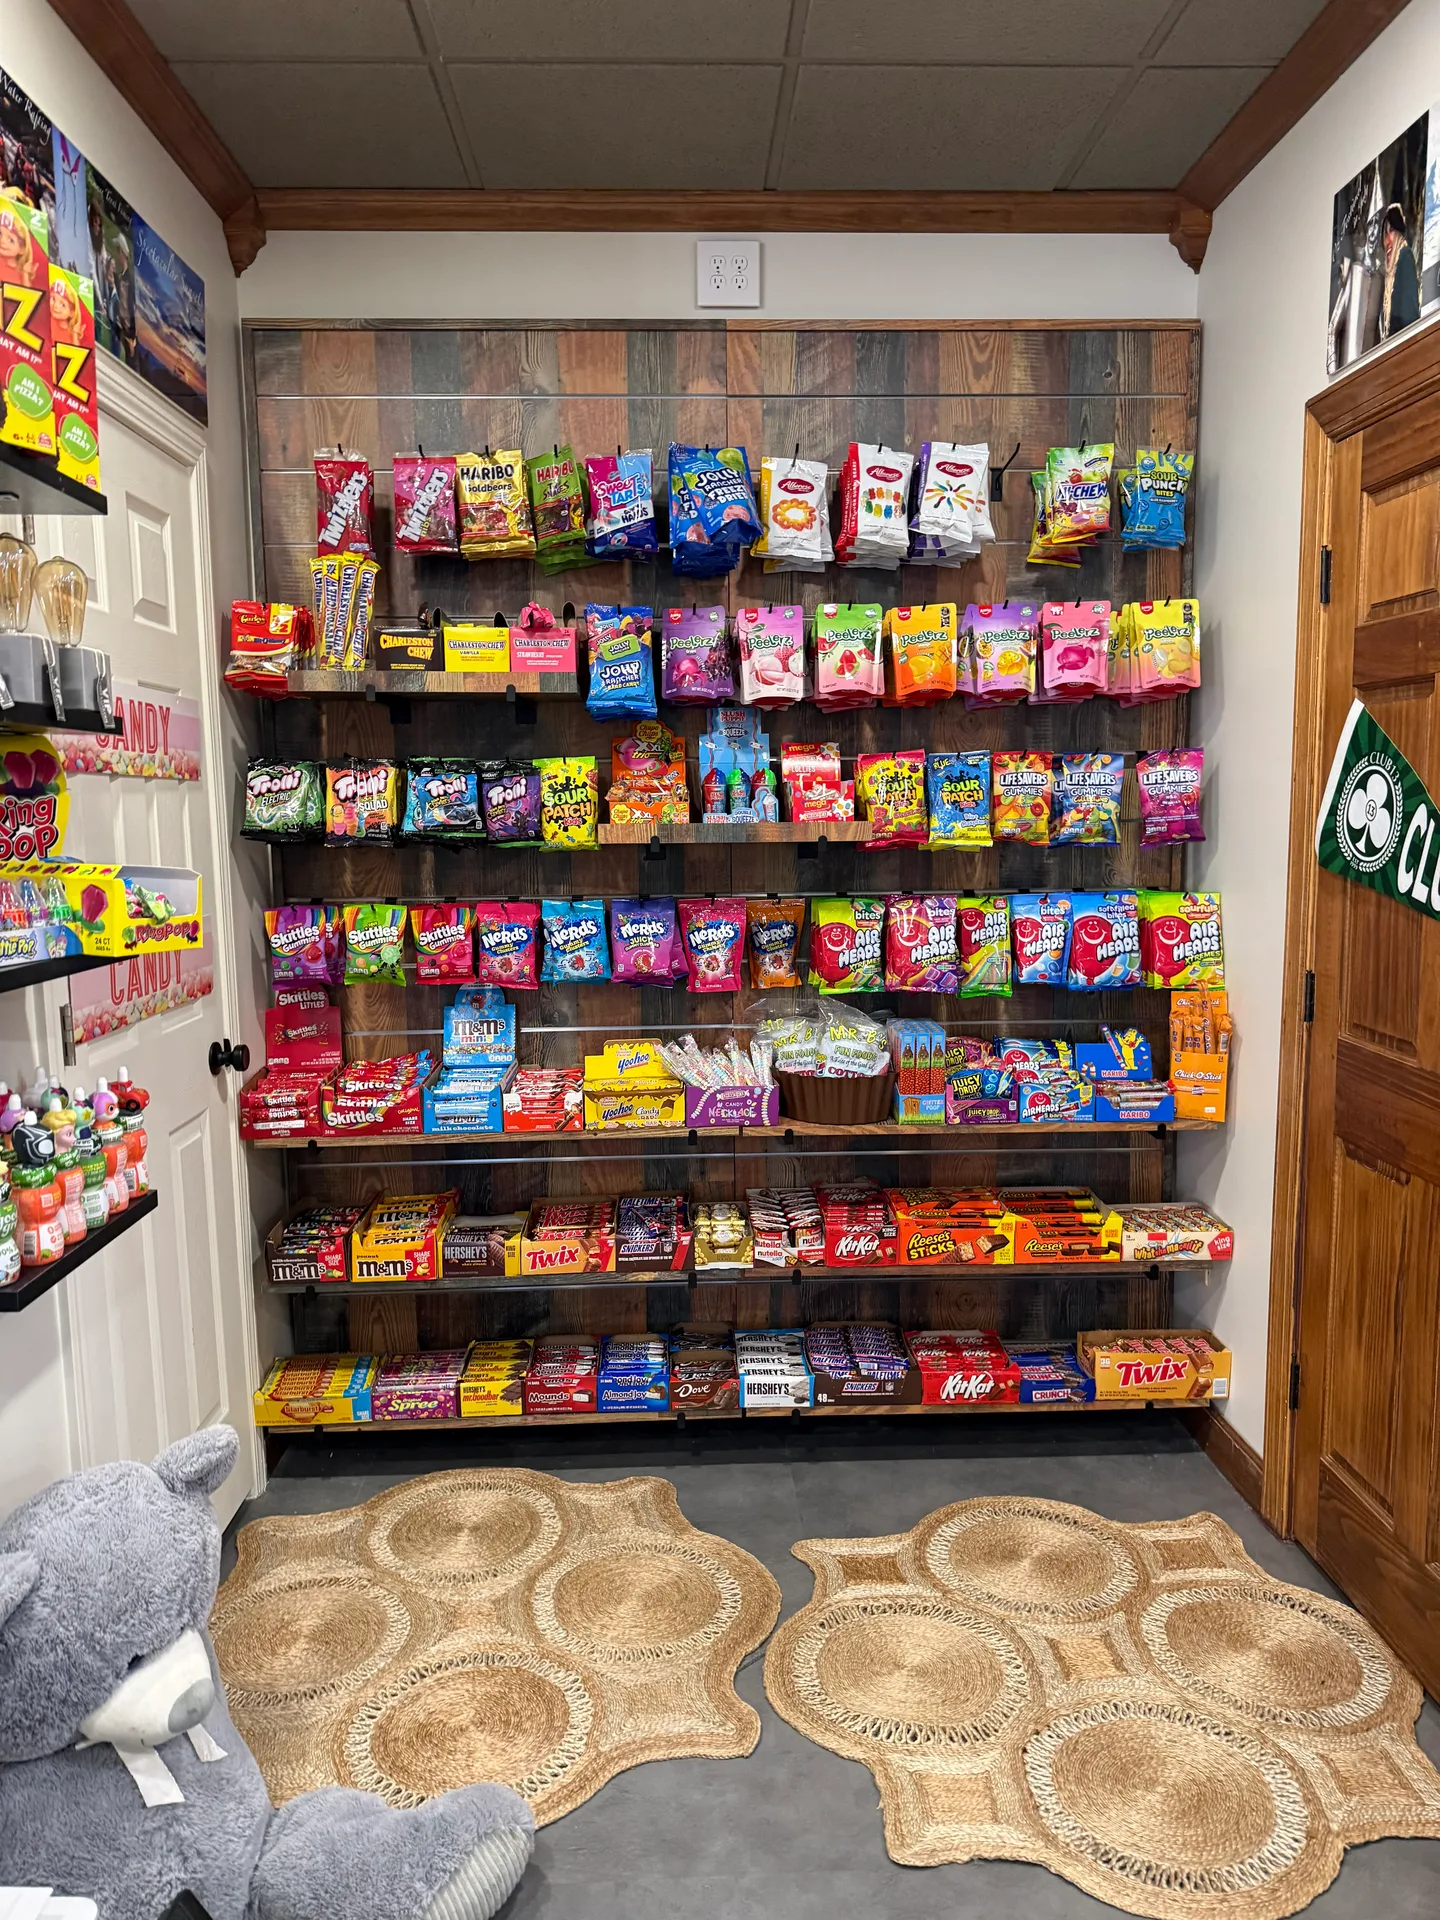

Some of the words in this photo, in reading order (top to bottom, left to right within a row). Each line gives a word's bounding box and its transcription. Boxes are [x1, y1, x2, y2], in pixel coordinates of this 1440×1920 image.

[25, 98, 51, 146] Rafting
[137, 230, 179, 267] Spectacular
[14, 385, 43, 407] PIZZA?
[65, 432, 90, 451] PIZZA?
[460, 464, 514, 481] HARIBO
[536, 459, 574, 484] HARIBO
[697, 467, 740, 487] JOLLY
[1150, 471, 1178, 480] SOUR
[466, 483, 512, 493] Goldbears
[704, 478, 744, 492] RANCHER
[1142, 478, 1184, 495] PUNCH
[420, 517, 431, 537] nibs
[336, 566, 357, 629] CHARLESTON
[826, 629, 872, 642] Peelerz
[901, 630, 948, 646] Peelerz
[983, 630, 1030, 643] Peelerz
[1051, 628, 1100, 640] Peelerz
[1144, 626, 1191, 640] Peelerz
[333, 628, 346, 660] CHEW
[380, 634, 434, 649] CHARLESTON
[448, 640, 486, 649] CHARLESTON
[487, 640, 506, 650] CHEW
[515, 639, 551, 647] CHARLESTON
[552, 639, 570, 647] CHEW
[610, 641, 630, 651] JOLLY
[670, 635, 713, 650] Peelerz
[748, 635, 794, 649] Peelerz
[407, 647, 434, 661] CHEW
[600, 662, 641, 678] JOLLY
[102, 688, 112, 715] VIP
[632, 739, 662, 752] XXL
[788, 743, 815, 752] mega
[632, 751, 650, 759] trio
[1370, 752, 1399, 782] CLUB13
[251, 771, 302, 796] Trolli
[333, 770, 388, 800] Trolli
[426, 776, 467, 797] Trolli
[941, 779, 980, 792] SOUR
[1149, 785, 1194, 796] GUMMIES
[487, 778, 527, 805] Trolli
[543, 787, 587, 805] SOUR
[941, 789, 985, 804] PATCH
[1003, 787, 1043, 797] GUMMIES
[1070, 787, 1112, 797] GUMMIES
[358, 800, 388, 811] SQUAD
[804, 799, 827, 808] mega
[1367, 804, 1375, 817] 13
[544, 802, 591, 821] PATCH
[855, 910, 881, 920] bites
[928, 907, 955, 917] bites
[1040, 906, 1065, 915] bites
[1178, 904, 1218, 914] sourfuls
[985, 913, 1007, 927] AIR
[270, 925, 320, 949] Skittles
[348, 925, 399, 945] Skittles
[418, 924, 466, 946] Skittles
[928, 925, 956, 944] AIR
[971, 924, 1007, 944] HEADS
[1041, 923, 1066, 941] AIR
[1112, 921, 1139, 940] AIR
[1189, 921, 1219, 940] AIR
[283, 936, 320, 953] Gummies
[359, 935, 399, 950] Gummies
[430, 934, 466, 950] Gummies
[855, 929, 881, 949] AIR
[911, 941, 956, 963] HEADS
[1027, 937, 1064, 956] HEADS
[1096, 937, 1139, 961] HEADS
[1173, 937, 1220, 961] HEADS
[838, 940, 881, 968] HEADS
[921, 953, 956, 968] XTREMES
[1184, 950, 1221, 965] XTREMES
[110, 950, 183, 1006] CANDY
[279, 990, 326, 1006] Skittles
[300, 1000, 325, 1010] LITTLES
[287, 1024, 318, 1038] Skittles
[460, 1034, 494, 1043] minis
[834, 1045, 851, 1056] FUN
[345, 1081, 402, 1092] Skittles
[952, 1074, 982, 1088] JUICY
[958, 1084, 981, 1095] DROP
[267, 1096, 297, 1106] Skittles
[327, 1111, 384, 1126] Skittles
[635, 1106, 660, 1118] Candy
[708, 1106, 757, 1119] NECKLACE
[1022, 1104, 1060, 1120] AIRHEADS
[1119, 1110, 1150, 1118] HARIBO
[537, 1230, 586, 1240] Twix
[909, 1231, 951, 1249] Reese's
[1214, 1236, 1231, 1246] king
[445, 1246, 487, 1259] HERSHEY'S
[620, 1243, 656, 1254] SNICKERS
[1025, 1239, 1064, 1252] Reese's
[1134, 1240, 1204, 1260] Whatchamacallit
[1217, 1242, 1231, 1250] size
[325, 1253, 342, 1261] SHARE
[526, 1244, 581, 1271] Twix
[273, 1263, 325, 1281] m&m's
[357, 1259, 412, 1277] m&m's
[1116, 1357, 1188, 1387] Twix
[463, 1386, 485, 1394] HERSHEY'S
[674, 1384, 710, 1397] Dove
[747, 1383, 789, 1395] HERSHEY'S
[844, 1383, 878, 1392] SNICKERS
[529, 1392, 570, 1402] Mounds
[602, 1391, 632, 1401] Almond
[632, 1391, 647, 1402] Joy
[817, 1393, 828, 1402] 48
[1034, 1391, 1069, 1400] CRUNCH
[285, 1405, 319, 1414] Starburst
[388, 1399, 438, 1412] Spree
